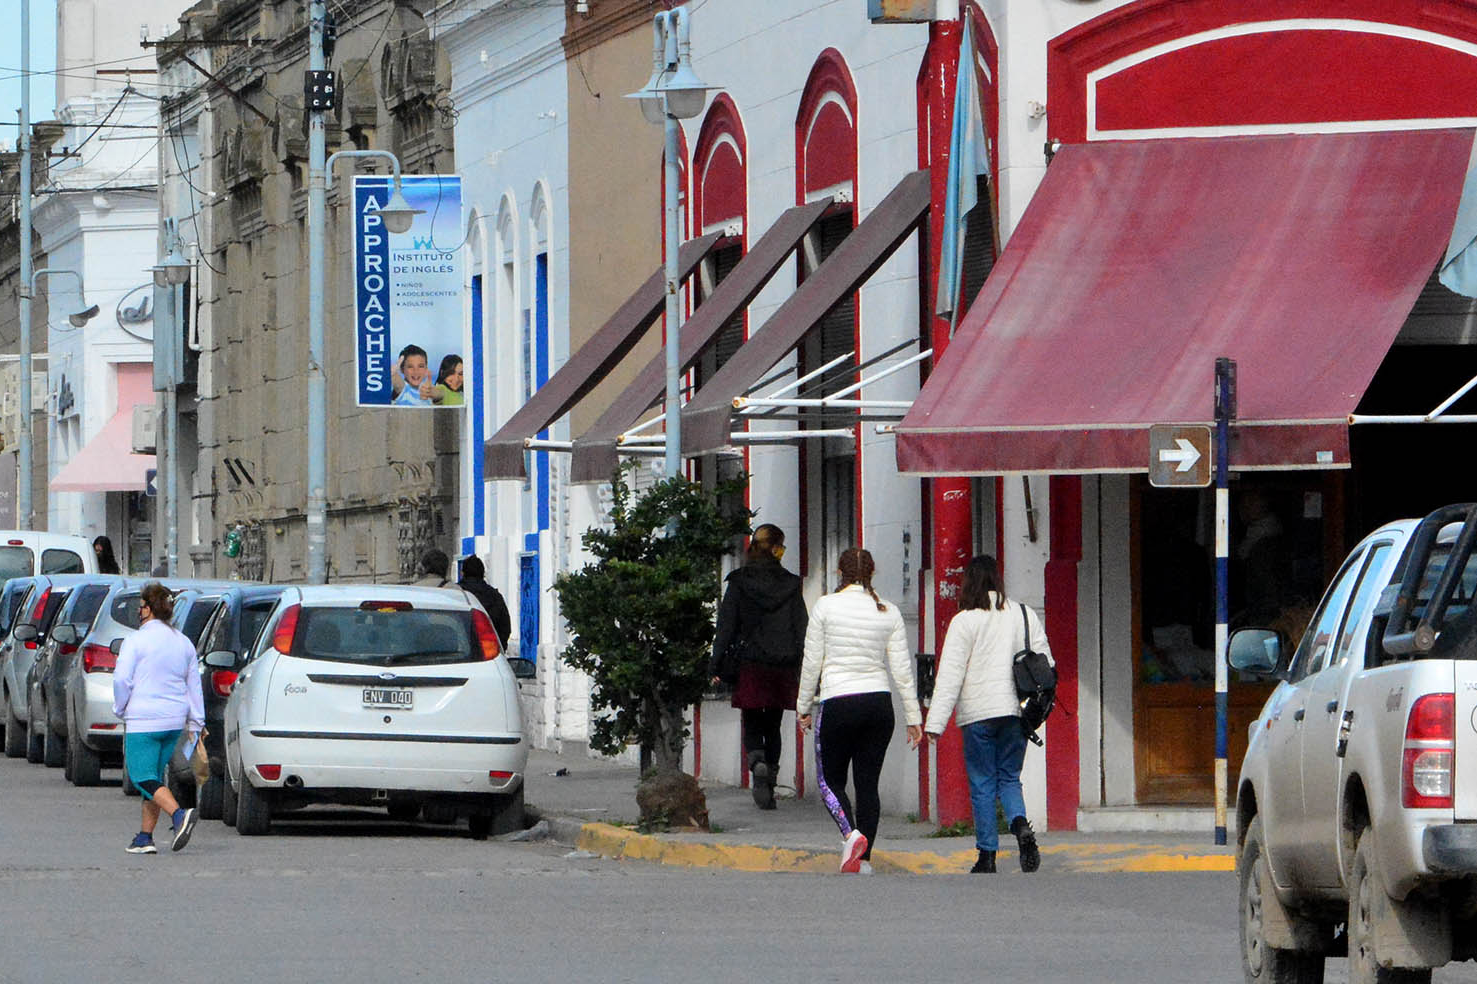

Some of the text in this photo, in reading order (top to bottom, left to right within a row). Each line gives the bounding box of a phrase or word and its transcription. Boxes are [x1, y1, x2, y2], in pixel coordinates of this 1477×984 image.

[393, 266, 409, 274] DE
[362, 195, 385, 392] APPROACHES
[364, 690, 412, 705] ENV 040
